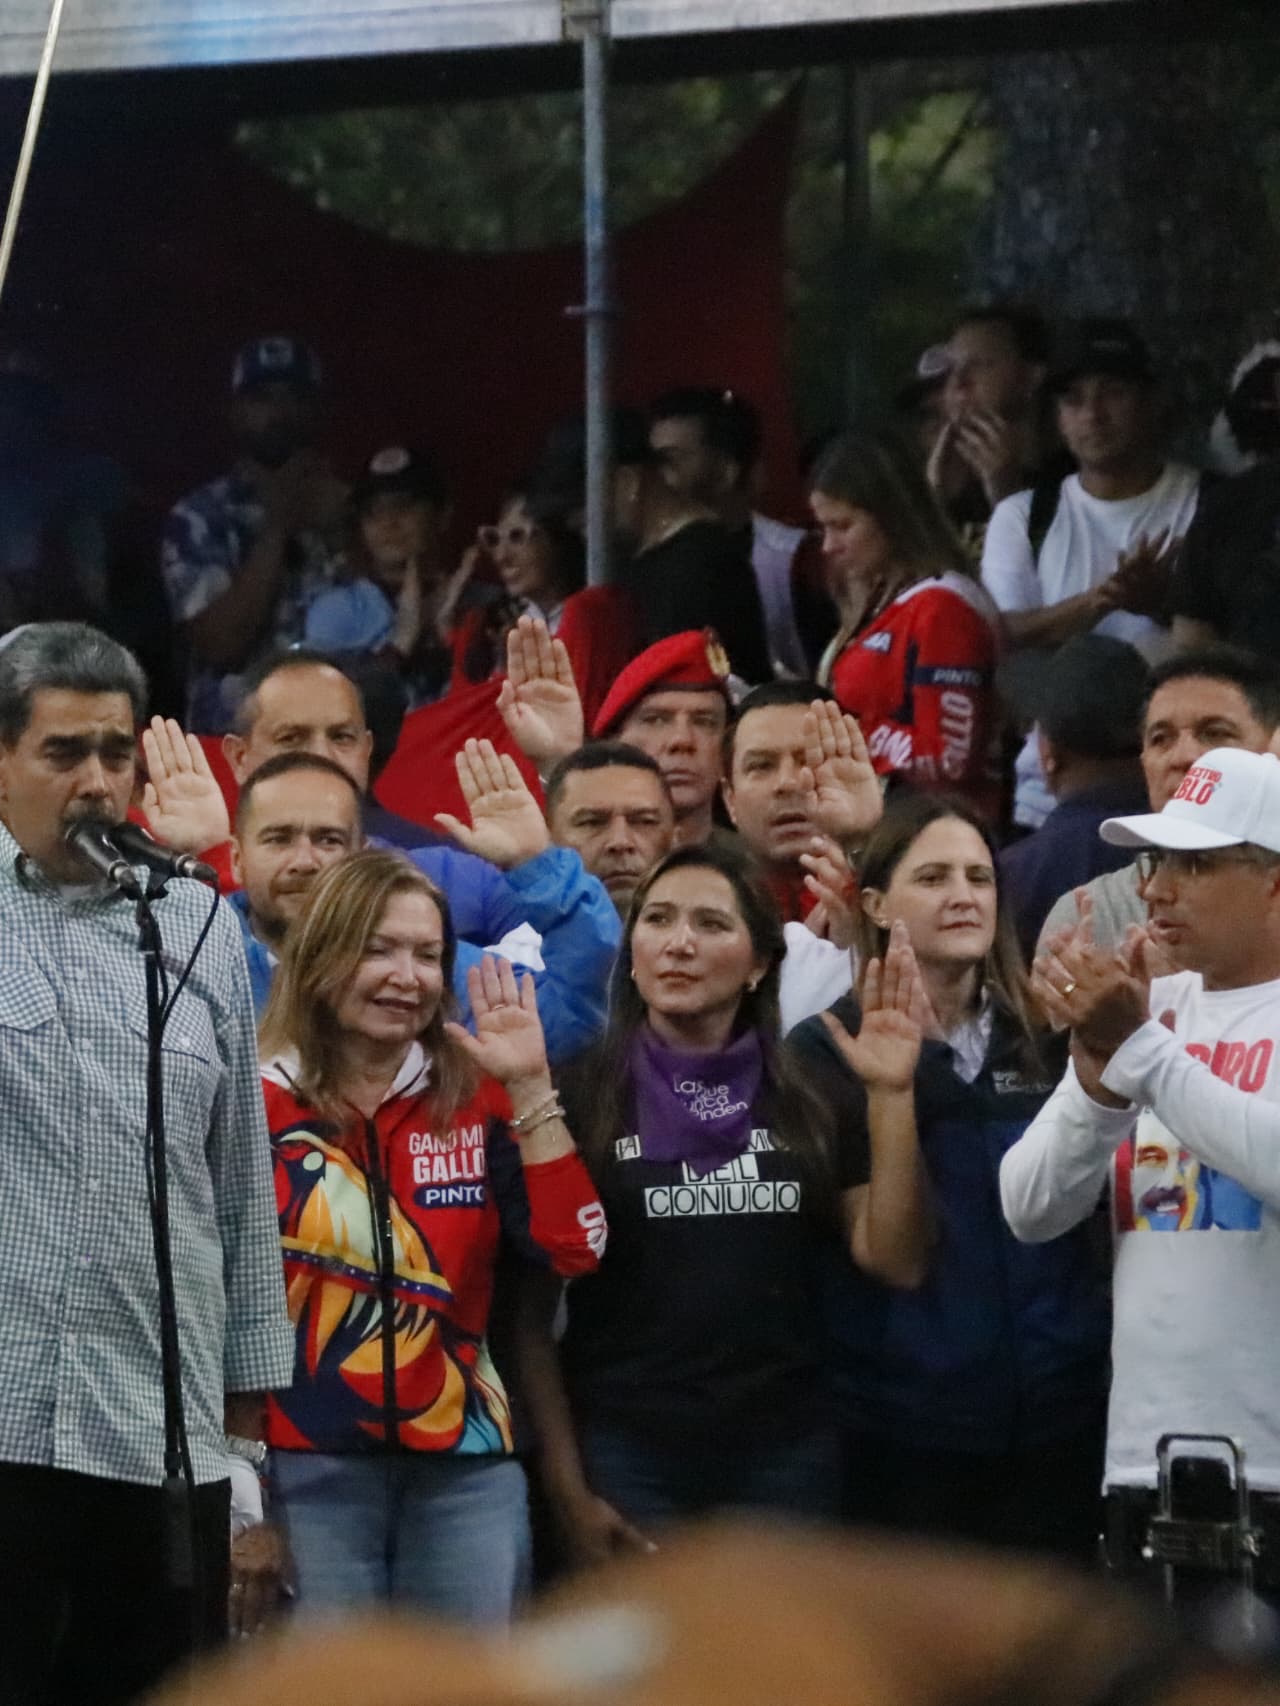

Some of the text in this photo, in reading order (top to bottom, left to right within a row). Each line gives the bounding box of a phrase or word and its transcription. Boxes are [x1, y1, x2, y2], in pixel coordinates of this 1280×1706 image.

[413, 1148, 485, 1184] GALLO
[425, 1186, 484, 1204] PINTO
[648, 1183, 799, 1216] CONUCO
